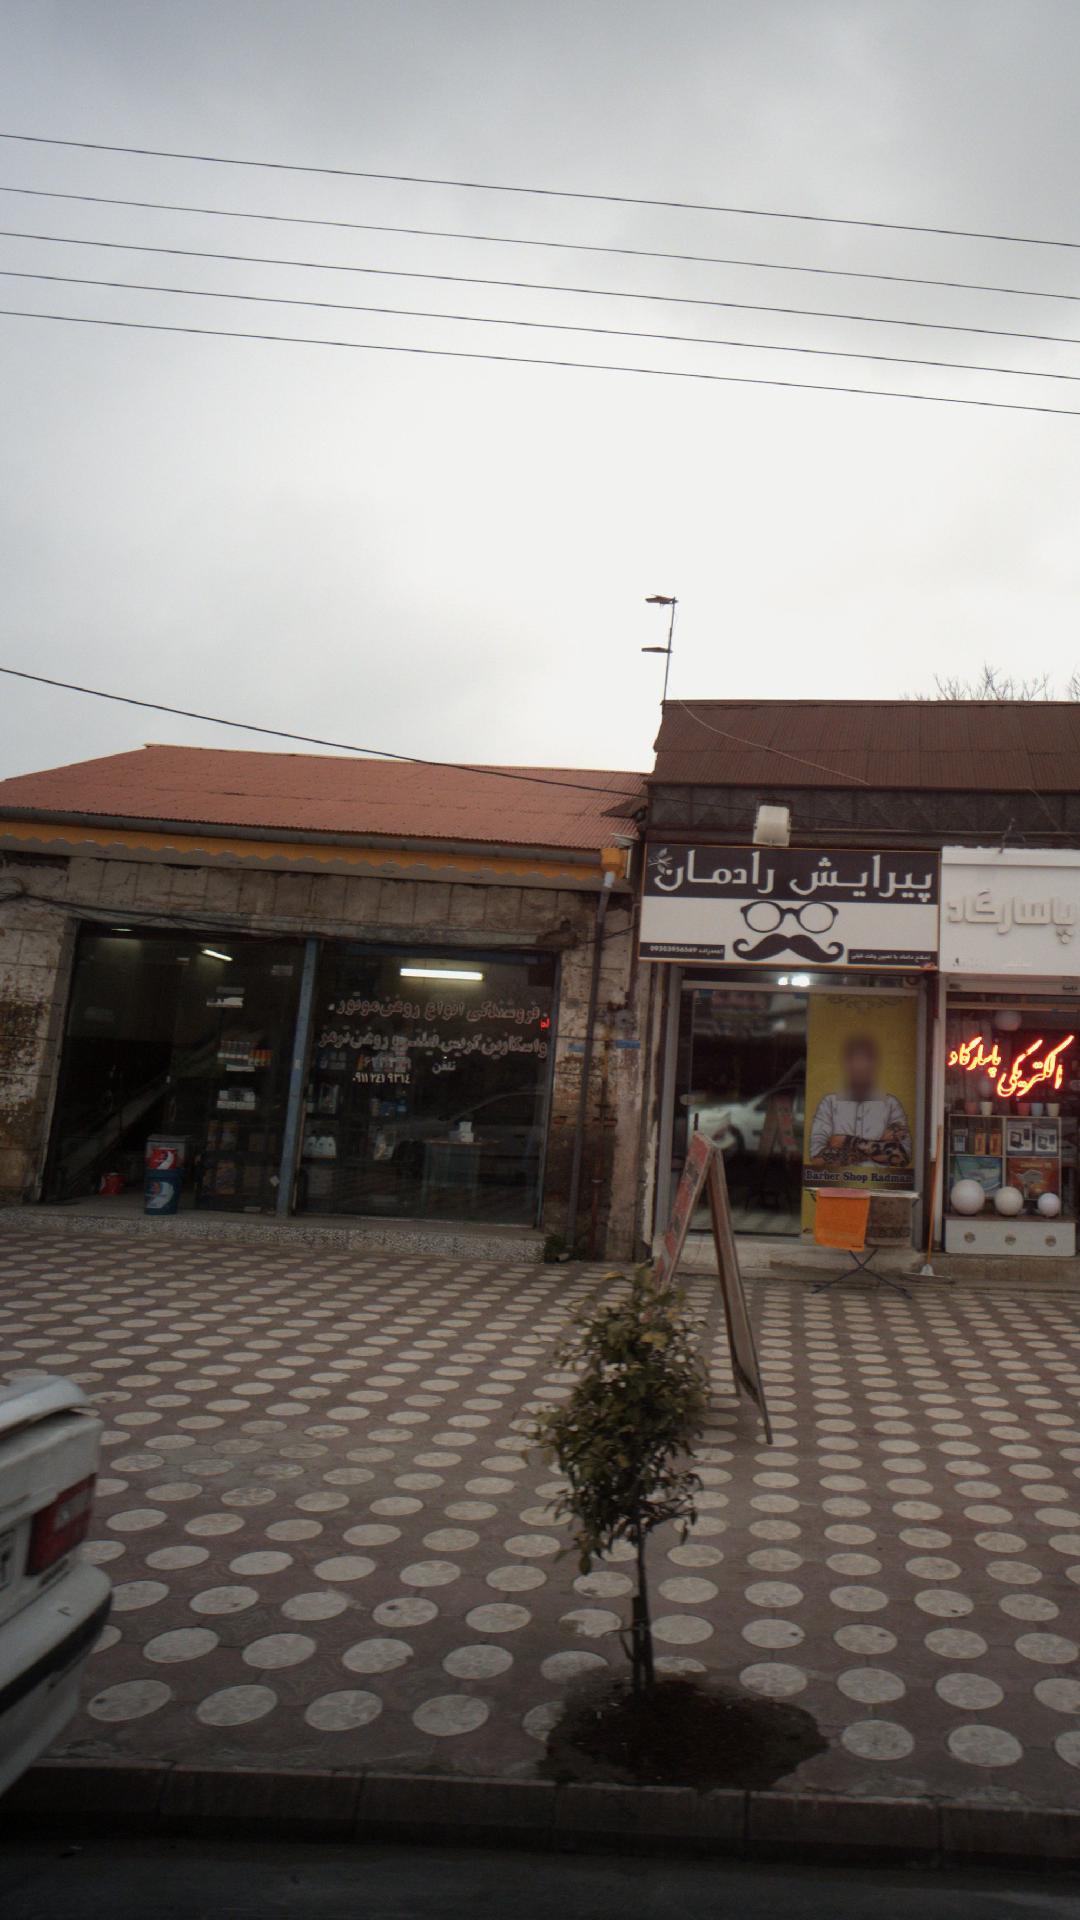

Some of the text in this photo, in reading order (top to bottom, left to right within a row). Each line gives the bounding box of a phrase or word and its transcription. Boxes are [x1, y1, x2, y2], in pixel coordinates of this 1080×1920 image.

[653, 849, 933, 903] پیرایش رادمان
[946, 888, 1076, 944] پاسارگاد
[806, 1168, 914, 1184] Barber Shop Radman
